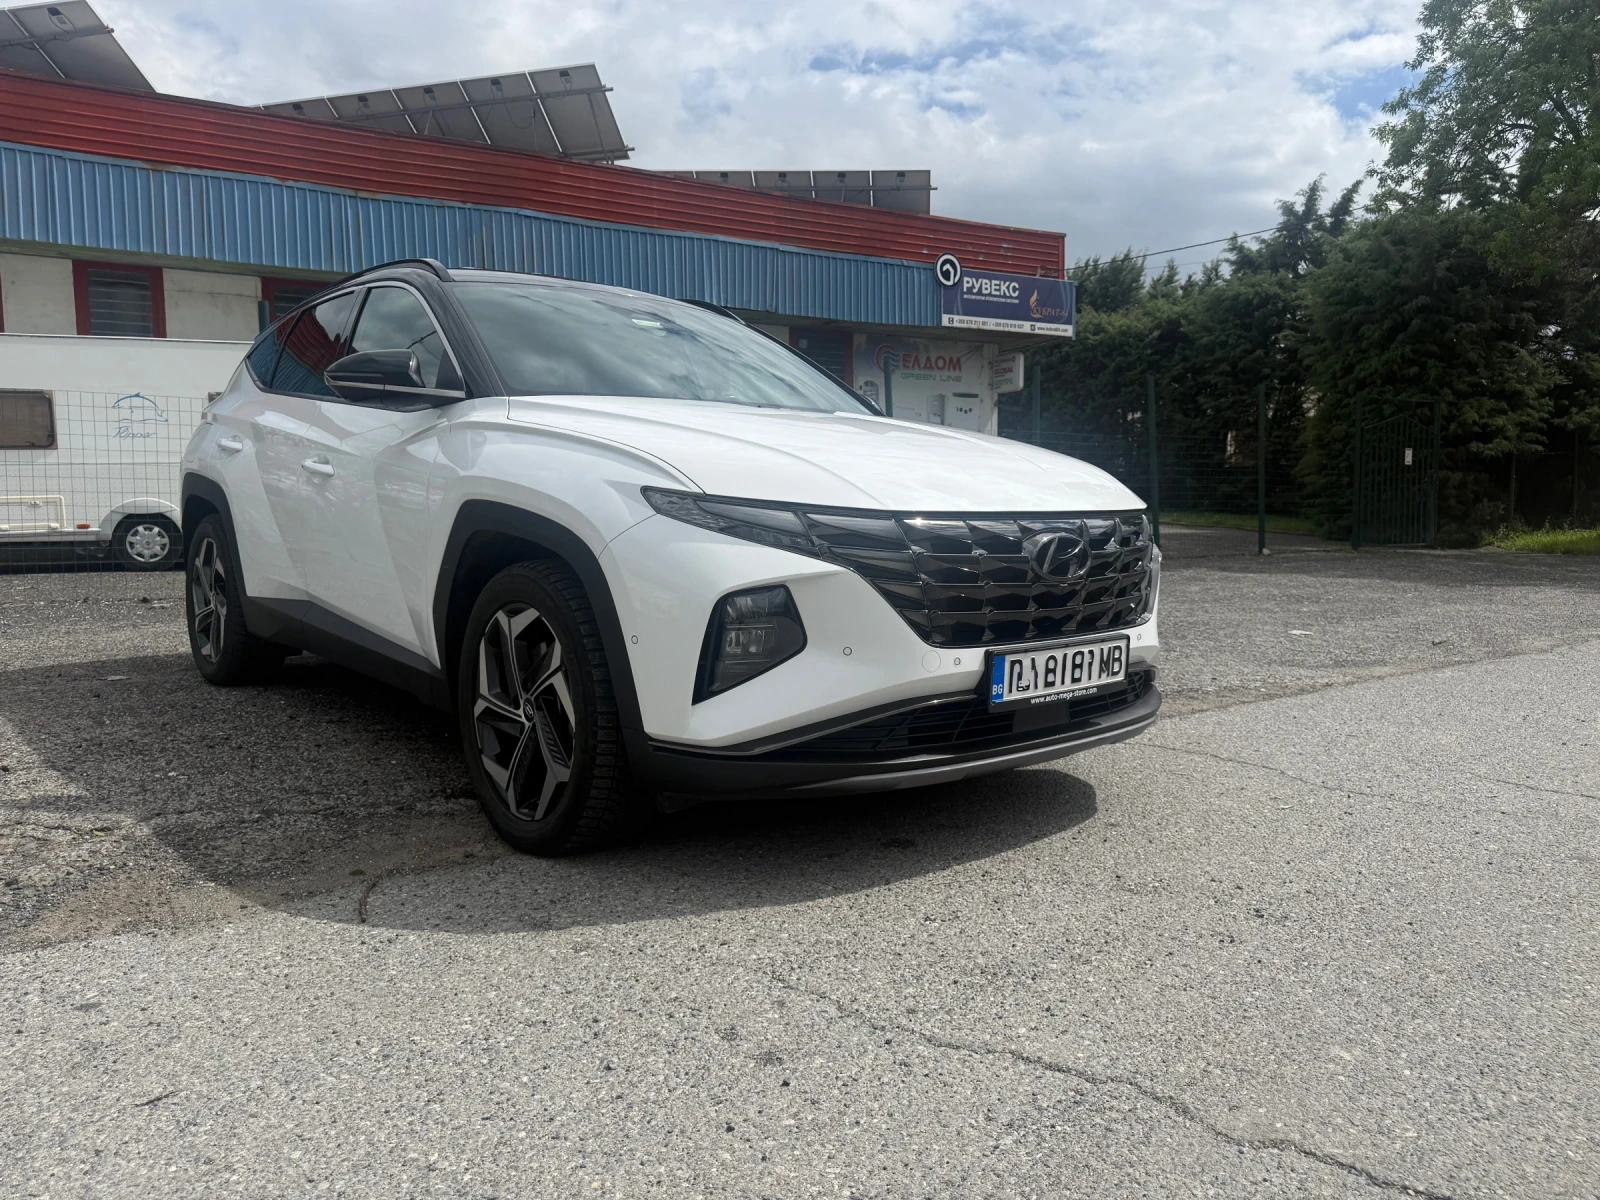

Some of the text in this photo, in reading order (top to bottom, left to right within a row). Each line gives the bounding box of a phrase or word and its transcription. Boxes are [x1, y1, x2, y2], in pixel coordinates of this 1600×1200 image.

[963, 276, 1020, 298] РУВЕКС
[901, 372, 962, 383] GREEN LINE
[992, 684, 1003, 695] BG
[1030, 687, 1097, 704] www.auto-mega-store.com
